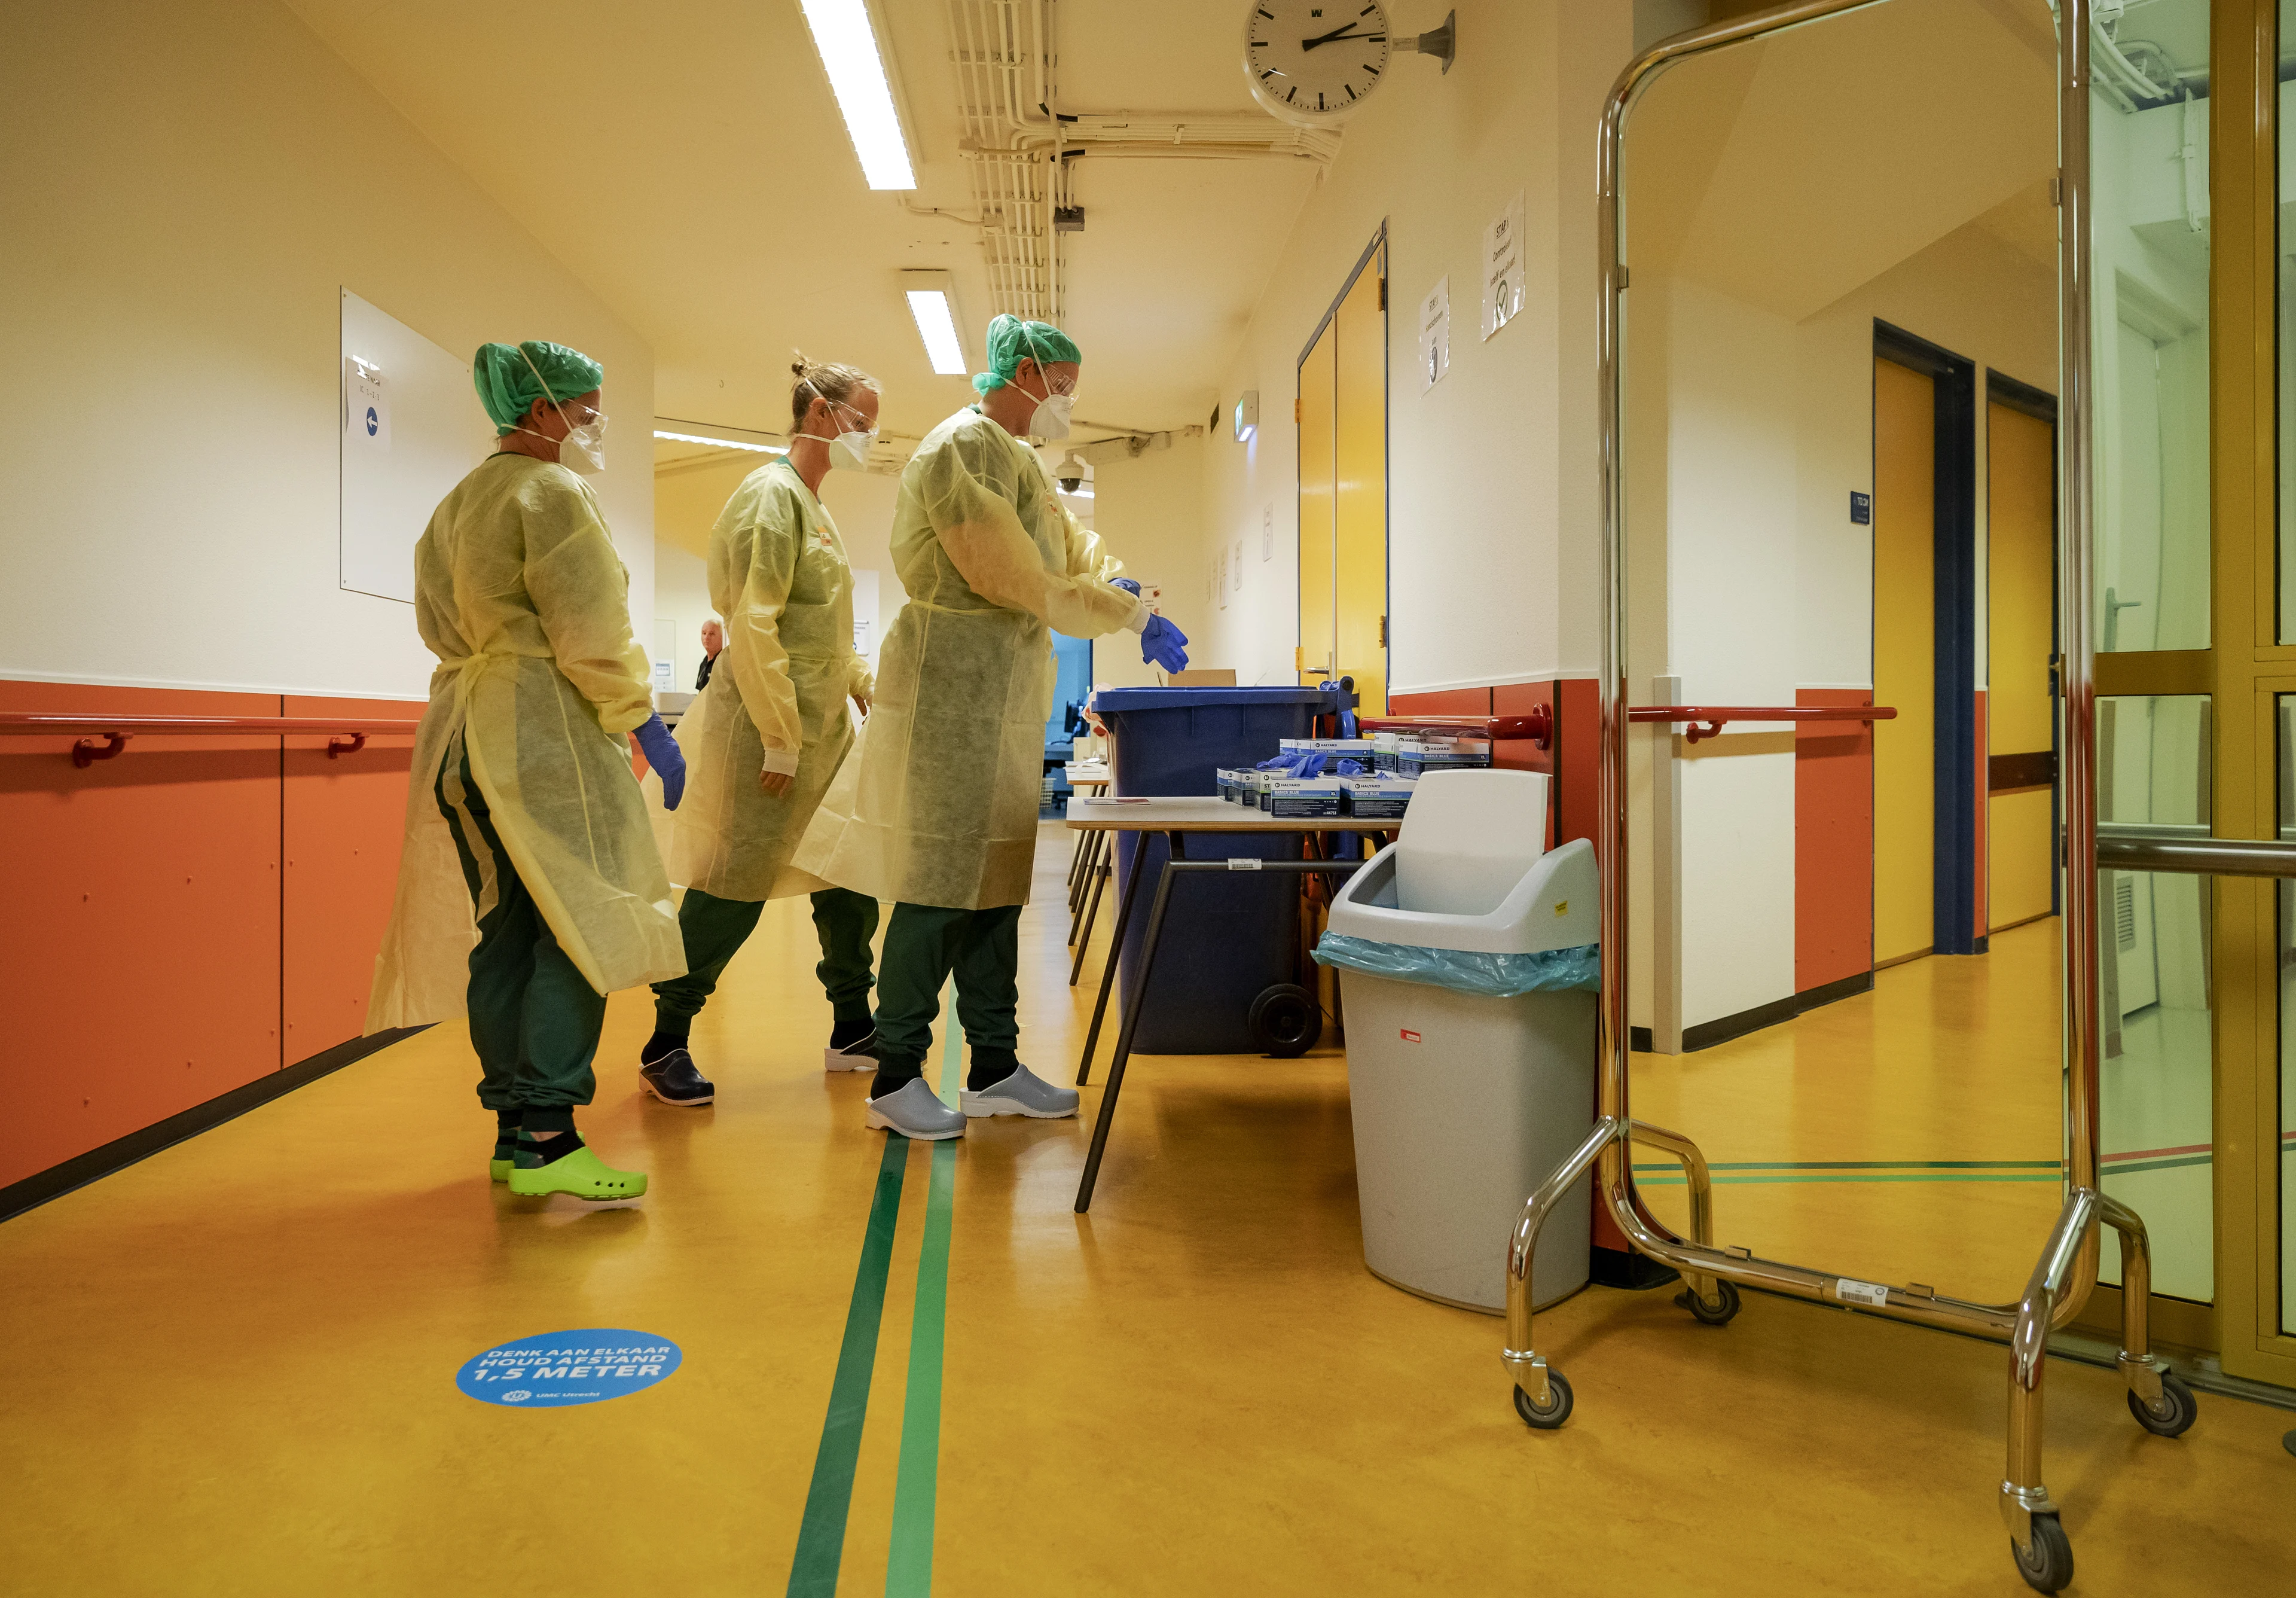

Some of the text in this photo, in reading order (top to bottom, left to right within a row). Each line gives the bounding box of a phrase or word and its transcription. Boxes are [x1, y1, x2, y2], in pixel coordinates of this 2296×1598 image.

[1496, 219, 1506, 238] STAP
[1500, 268, 1505, 279] en
[594, 1347, 670, 1355] ELKAAR
[479, 1355, 667, 1367] HOUD AFSTAND
[474, 1364, 662, 1382] 1,5 METER
